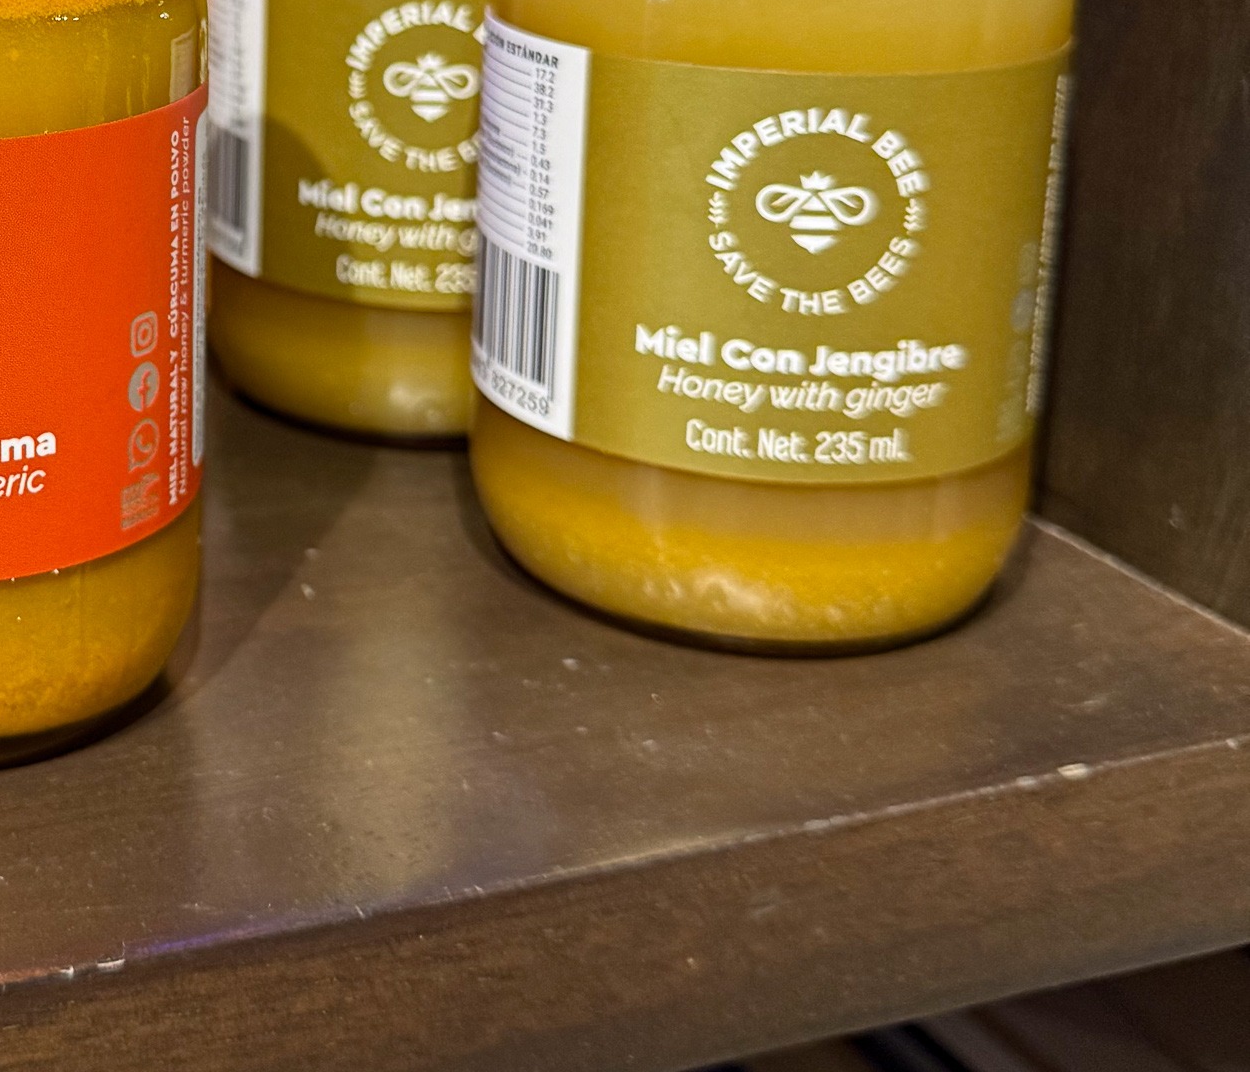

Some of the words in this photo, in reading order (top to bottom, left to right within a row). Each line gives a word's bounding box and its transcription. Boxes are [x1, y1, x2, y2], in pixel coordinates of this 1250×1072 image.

[345, 0, 473, 71] IMPERIAL
[170, 130, 180, 199] POLVO
[182, 116, 191, 193] powder
[349, 100, 404, 163] SAVE
[404, 145, 463, 172] THE
[705, 107, 873, 191] IMPERIAL
[871, 130, 930, 197] BEE
[170, 203, 180, 232] EN
[298, 179, 359, 214] Miel
[360, 188, 429, 220] Con
[315, 212, 398, 252] Honey
[399, 222, 459, 251] with
[180, 200, 190, 285] turmeric
[708, 231, 780, 304] SAVE
[780, 287, 848, 316] THE
[847, 236, 919, 305] BEES
[168, 235, 179, 338] CÚRCUMA
[180, 311, 190, 371] honey
[635, 323, 716, 366] Miel
[720, 338, 808, 375] Con
[808, 339, 968, 382] Jengibre
[169, 364, 178, 456] NATURAL
[179, 377, 188, 414] raw
[657, 363, 768, 414] Honey
[769, 380, 844, 411] with
[842, 380, 949, 419] ginger
[179, 420, 188, 495] Natural
[685, 418, 751, 458] Cont.
[756, 427, 813, 463] Net.
[814, 429, 869, 465] 235
[869, 427, 913, 463] ml.
[169, 457, 178, 505] MIEL
